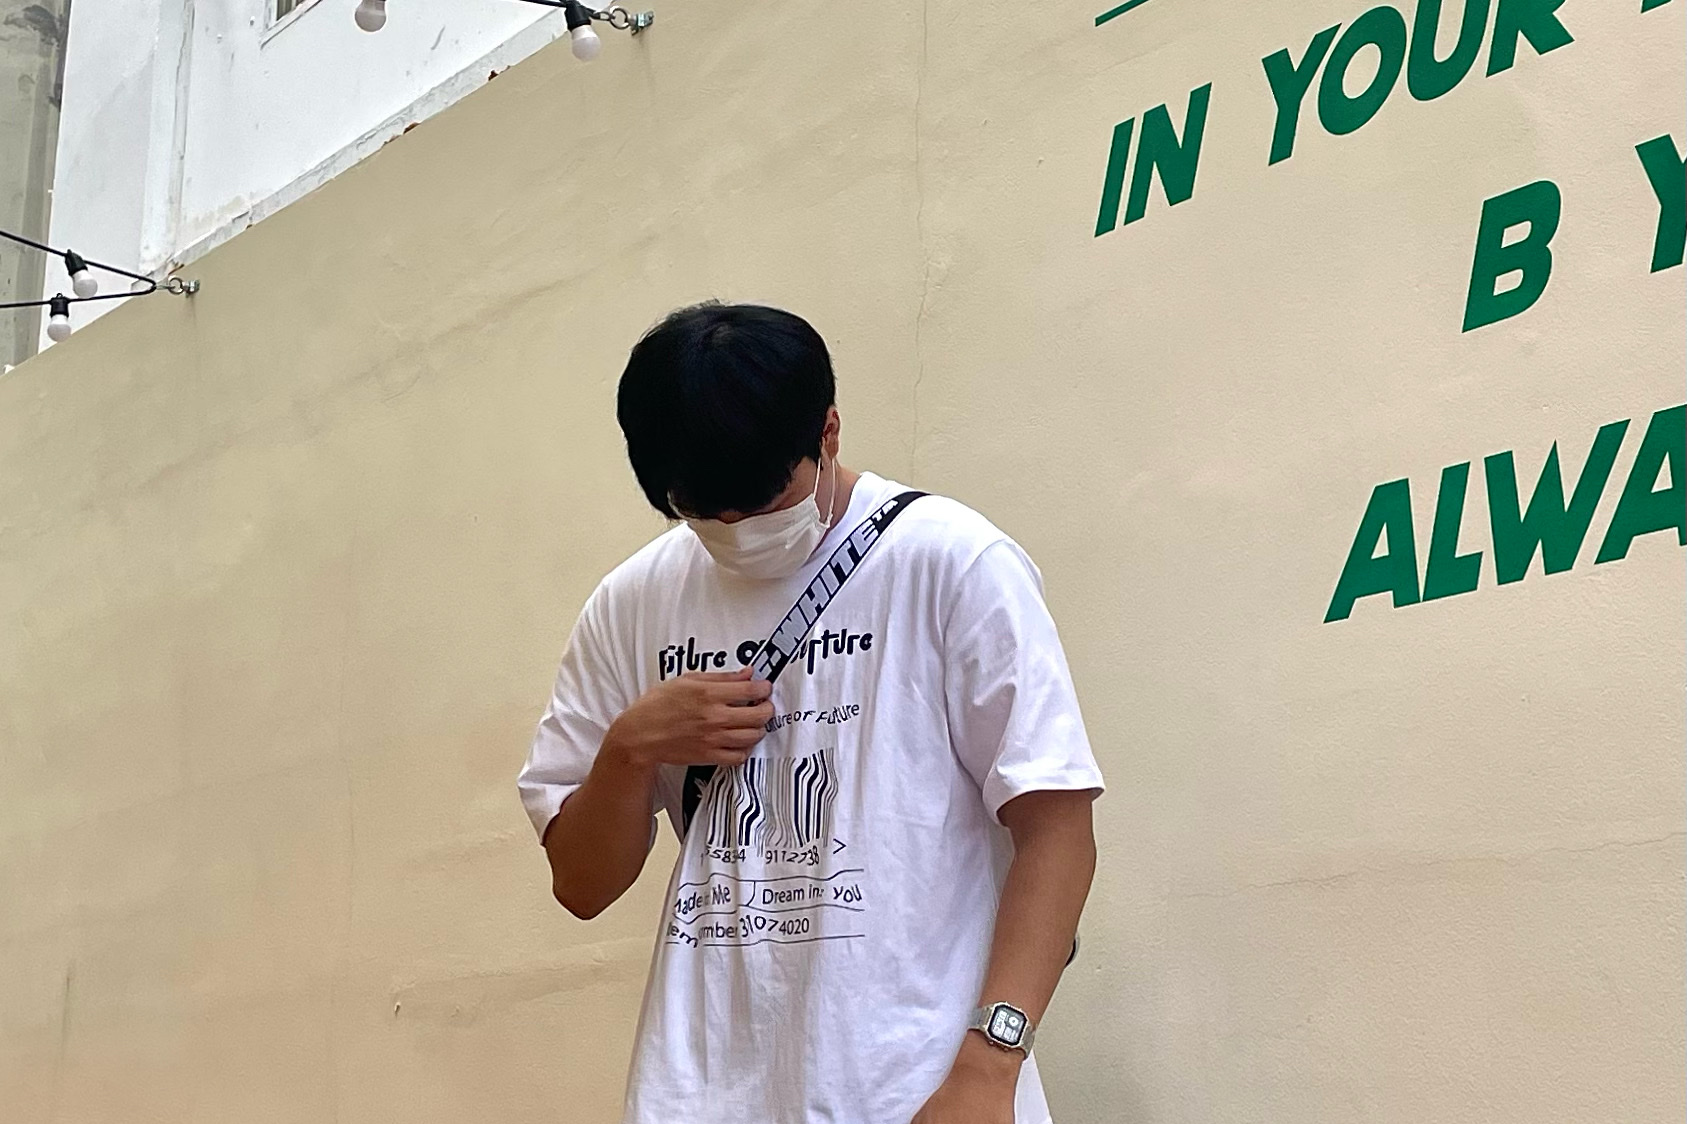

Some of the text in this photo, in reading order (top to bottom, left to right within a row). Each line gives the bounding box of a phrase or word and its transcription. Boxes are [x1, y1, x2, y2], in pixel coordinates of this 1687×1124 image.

[1094, 0, 1576, 238] IN YOUR
[1461, 179, 1562, 333] B
[1323, 402, 1687, 624] ALWA
[762, 887, 805, 905] Dream
